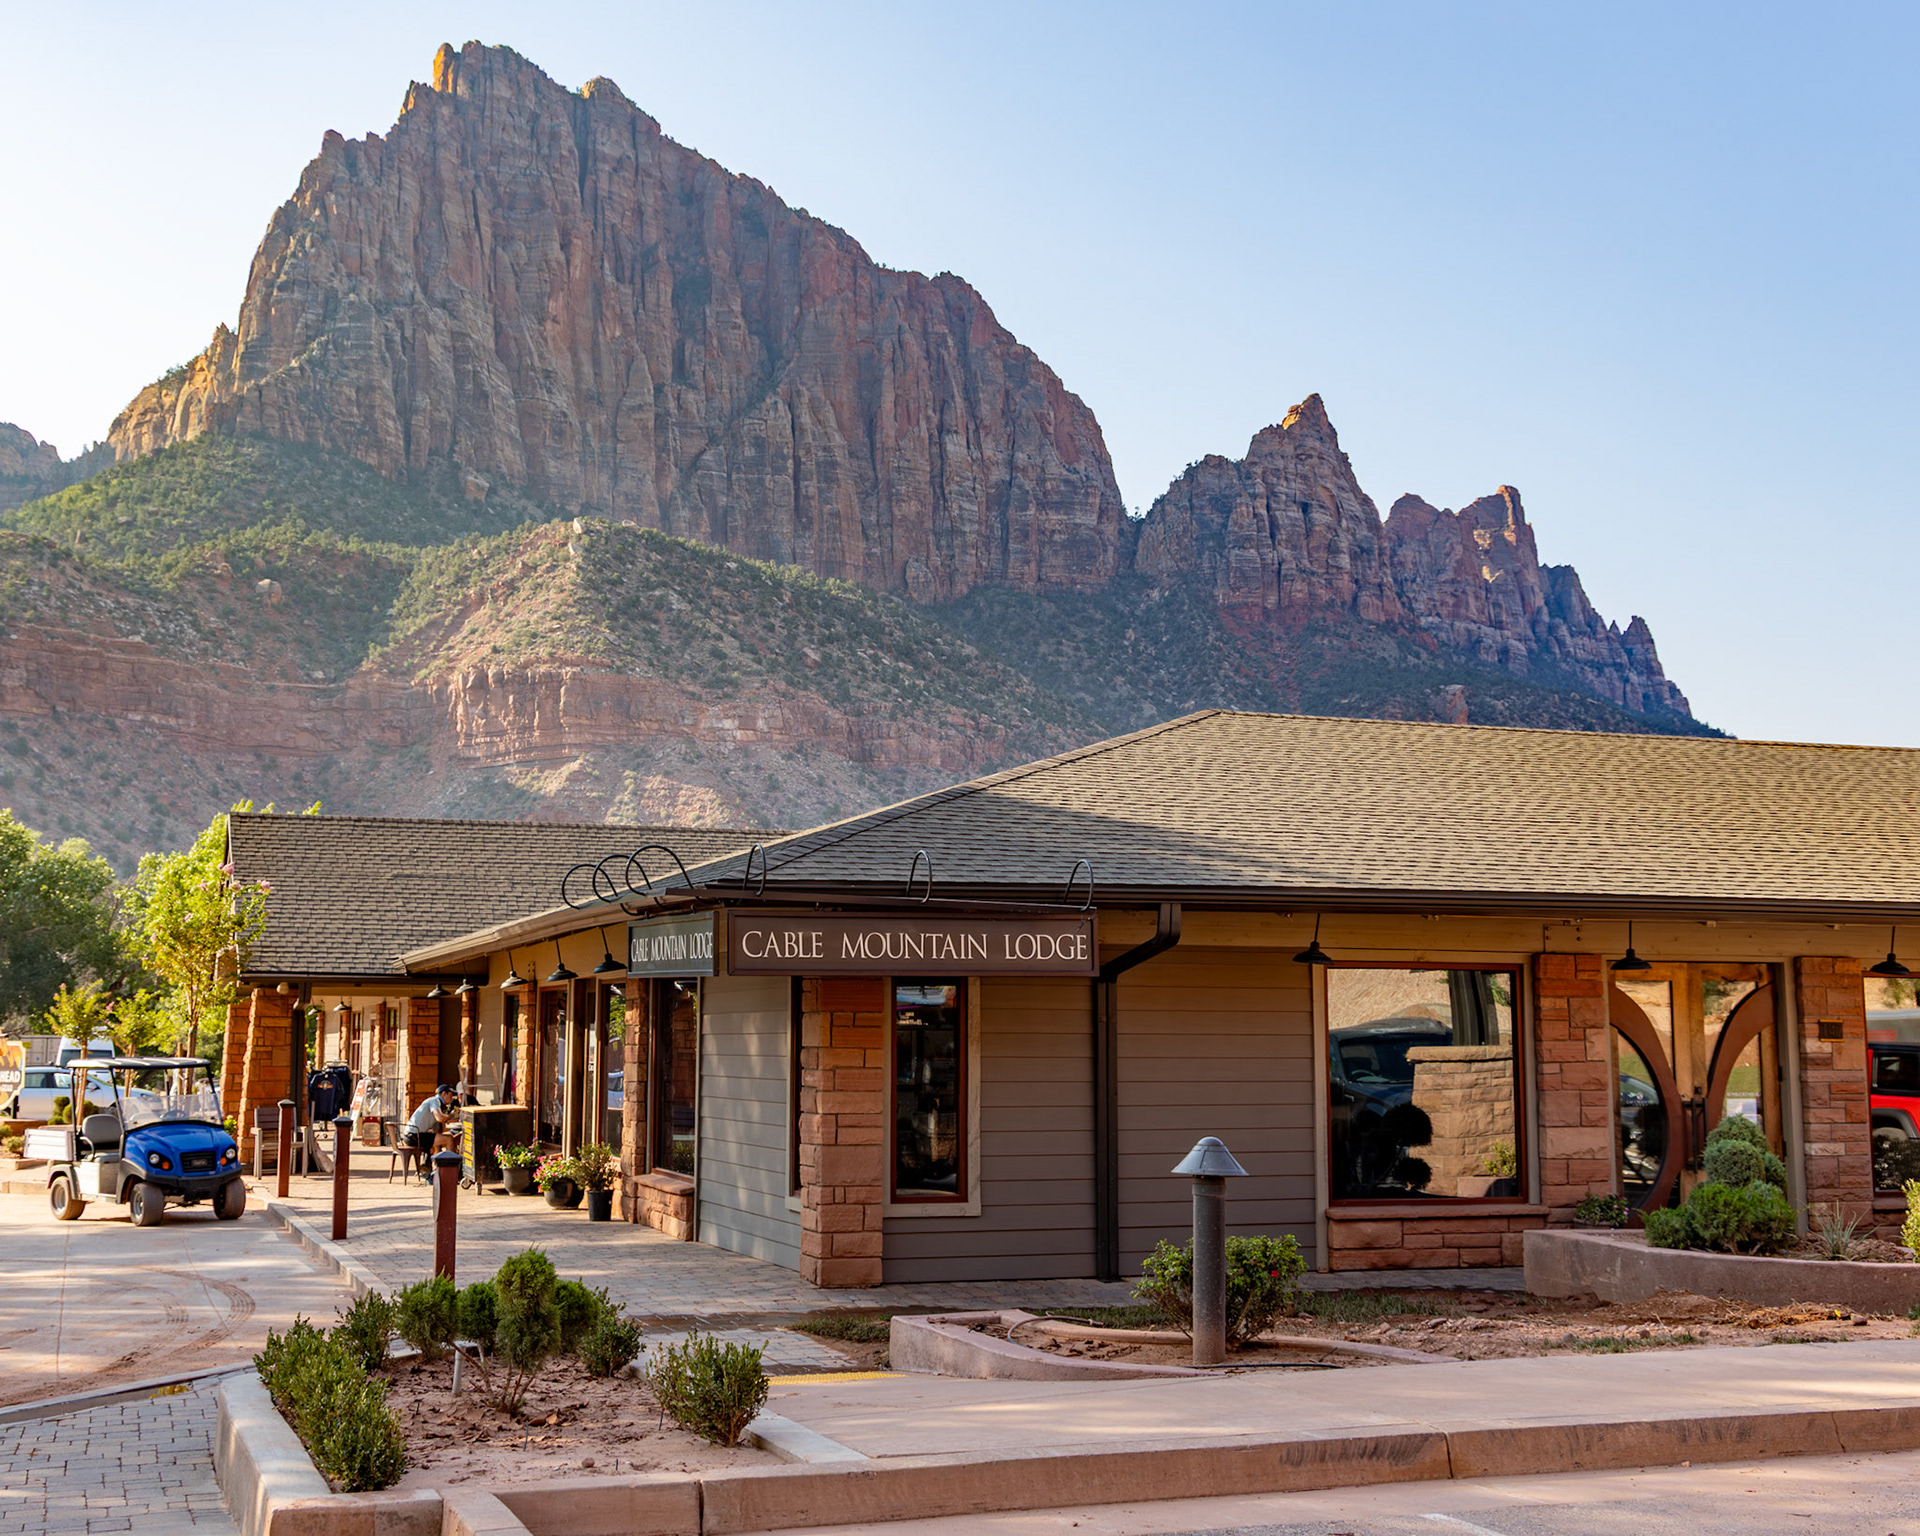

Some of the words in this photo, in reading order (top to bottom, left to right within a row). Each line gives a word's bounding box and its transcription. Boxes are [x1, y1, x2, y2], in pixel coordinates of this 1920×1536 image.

[631, 938, 649, 962] CABLE
[651, 934, 687, 961] MOUNTAIN
[689, 931, 713, 959] LODGE
[742, 930, 824, 958] CABLE
[840, 931, 988, 959] MOUNTAIN
[1004, 933, 1088, 960] LODGE
